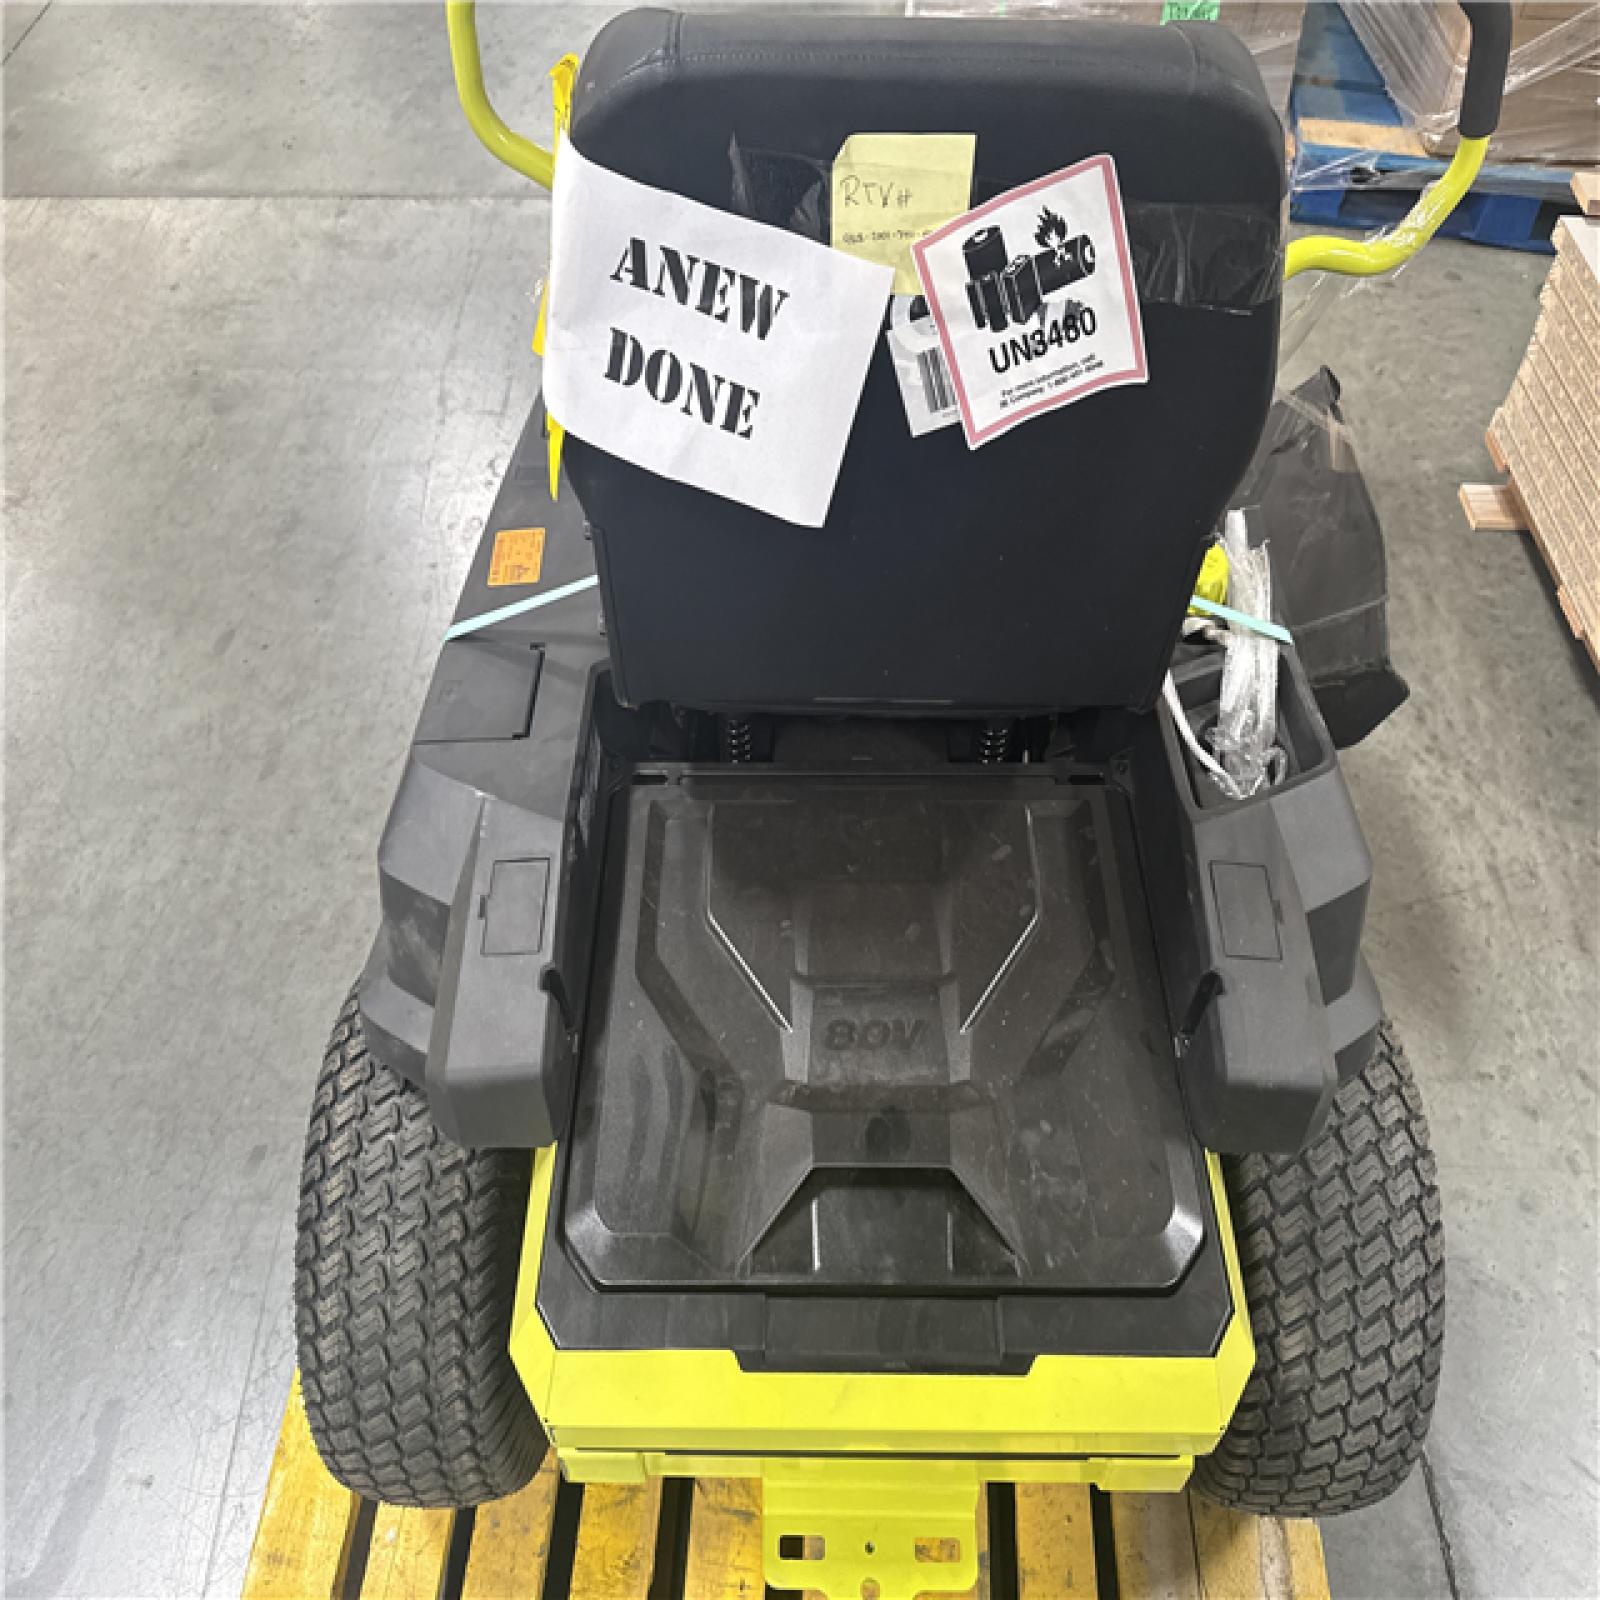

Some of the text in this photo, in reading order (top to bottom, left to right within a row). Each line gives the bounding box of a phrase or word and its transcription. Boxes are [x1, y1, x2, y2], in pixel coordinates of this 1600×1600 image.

[610, 237, 790, 341] ANEW
[989, 306, 1096, 374] UN3480
[604, 327, 760, 440] DONE
[824, 1019, 928, 1051] 80V
